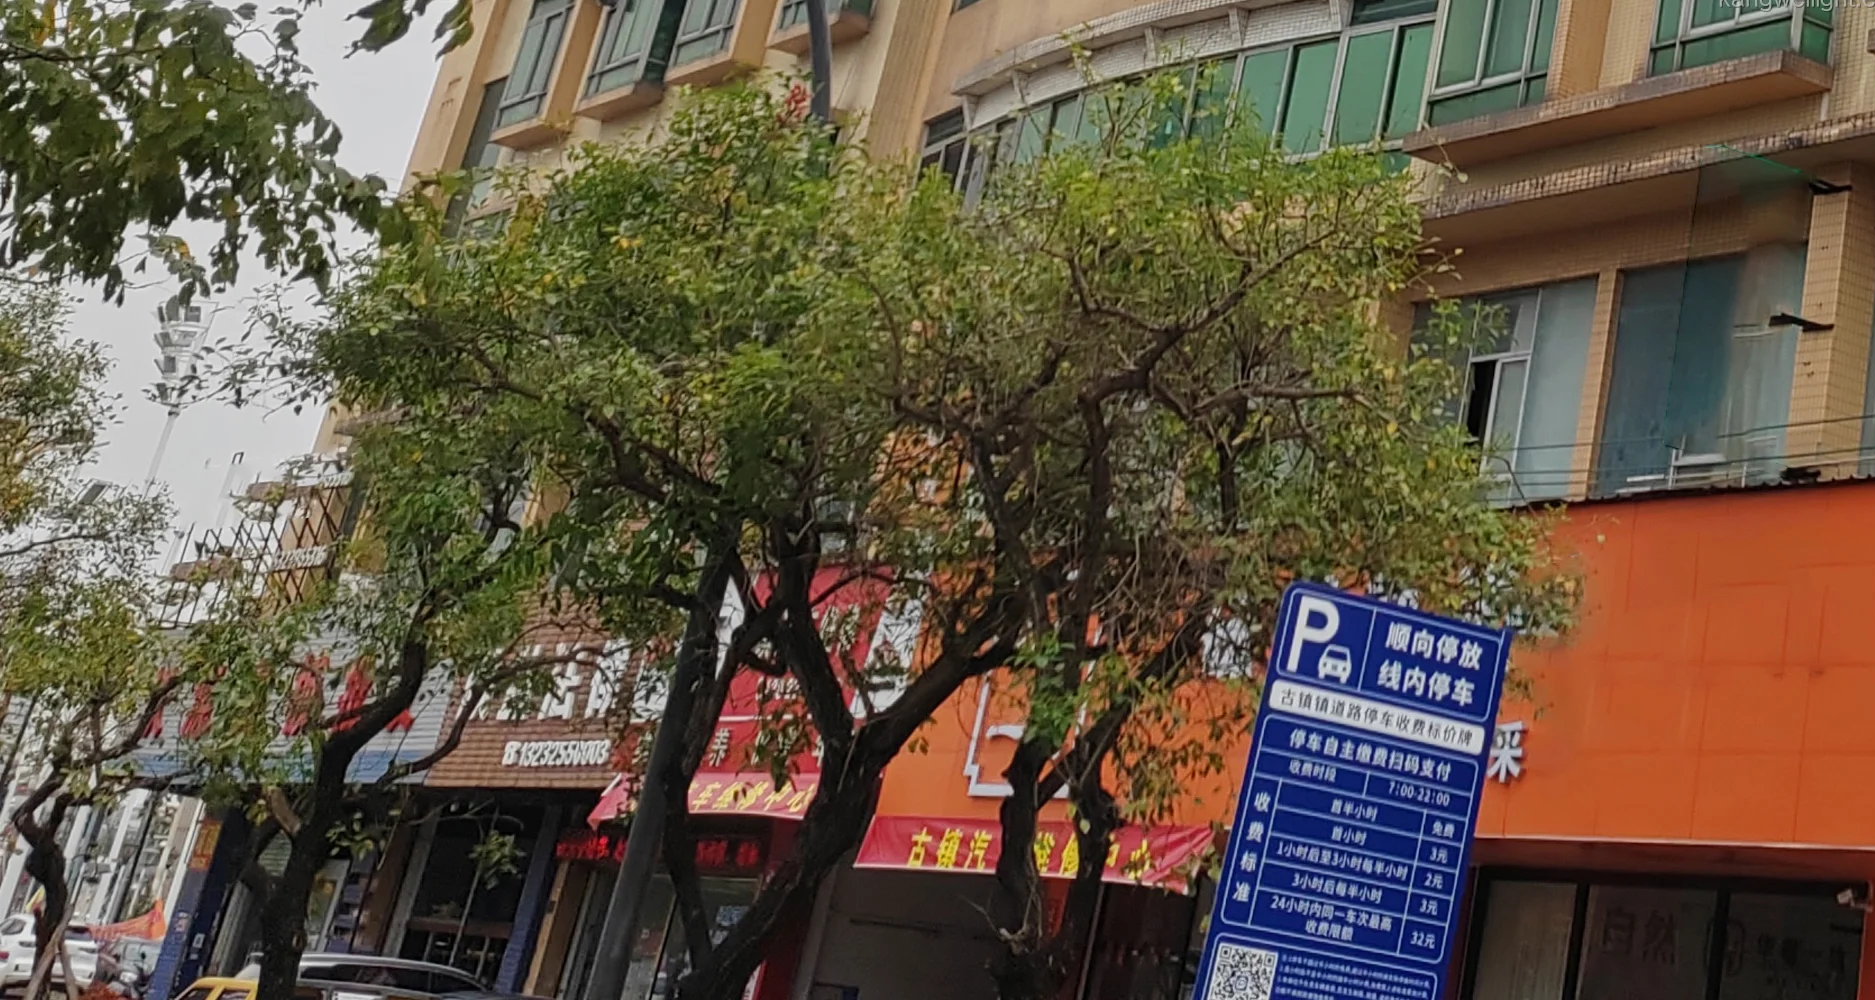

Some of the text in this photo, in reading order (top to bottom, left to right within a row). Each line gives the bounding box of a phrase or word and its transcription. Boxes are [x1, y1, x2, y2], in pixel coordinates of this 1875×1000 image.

[1285, 595, 1341, 674] P
[1384, 621, 1484, 671] 顺向停放
[1376, 658, 1476, 707] 线内停车
[1280, 687, 1474, 747] 古镇镇道路停车收费标价牌
[1289, 728, 1452, 783] 停车自主缴费扫码支付
[1288, 759, 1337, 784] 收费时段
[1330, 798, 1379, 823] 首半小时
[1331, 825, 1367, 847] 首小时
[1431, 820, 1456, 839] 免费
[1232, 790, 1271, 903] 收费标准
[1429, 847, 1449, 865] 3元
[1291, 873, 1383, 905] 3小时后每半小时
[1424, 872, 1444, 890] 2元
[1419, 898, 1439, 916] 3元
[1409, 930, 1437, 950] 32元
